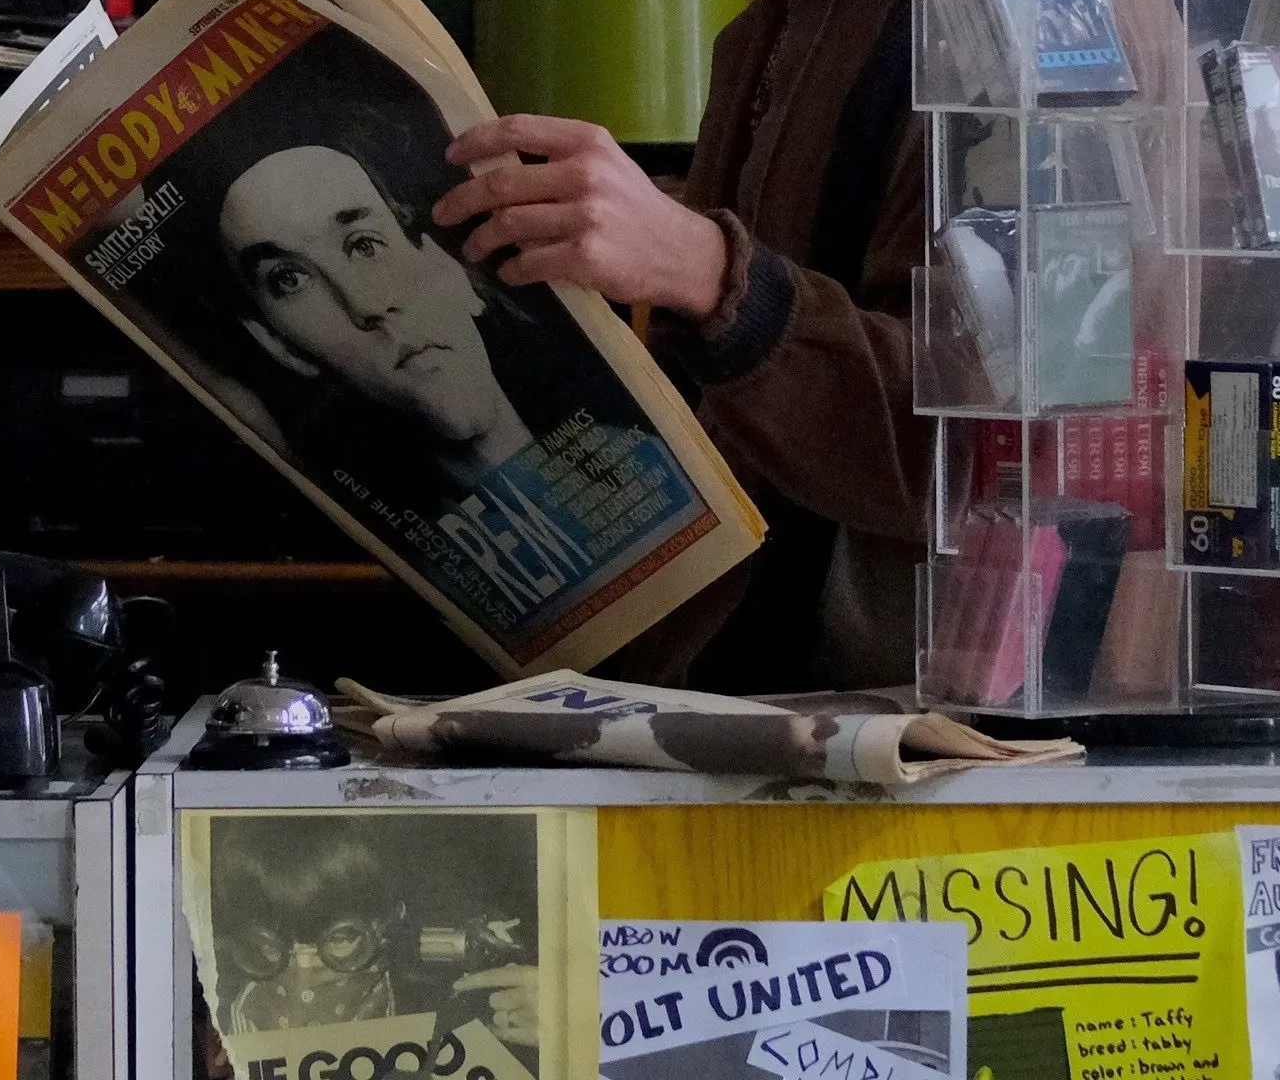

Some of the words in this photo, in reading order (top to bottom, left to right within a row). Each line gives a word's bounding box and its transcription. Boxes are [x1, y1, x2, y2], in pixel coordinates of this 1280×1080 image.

[24, 81, 186, 244] MELODY
[84, 215, 144, 275] SMITHS
[132, 180, 185, 234] SPLIT!
[103, 257, 131, 291] FULL
[127, 233, 167, 271] STORY
[542, 406, 595, 453] MANIACS
[584, 422, 647, 478] PALOMINOS
[330, 462, 371, 503] END
[612, 453, 644, 485] BOYS
[369, 495, 403, 530] THE
[1190, 515, 1209, 553] 60
[401, 505, 464, 568] WORLD
[403, 525, 441, 563] FOR
[436, 469, 594, 616] REM
[460, 564, 493, 597] THE
[839, 848, 1206, 946] MISSING!
[708, 948, 893, 1022] UNITED
[1139, 1006, 1194, 1029] Taffy
[1137, 1057, 1186, 1076] brown
[1192, 1052, 1220, 1070] and
[1141, 1032, 1193, 1056] tabby
